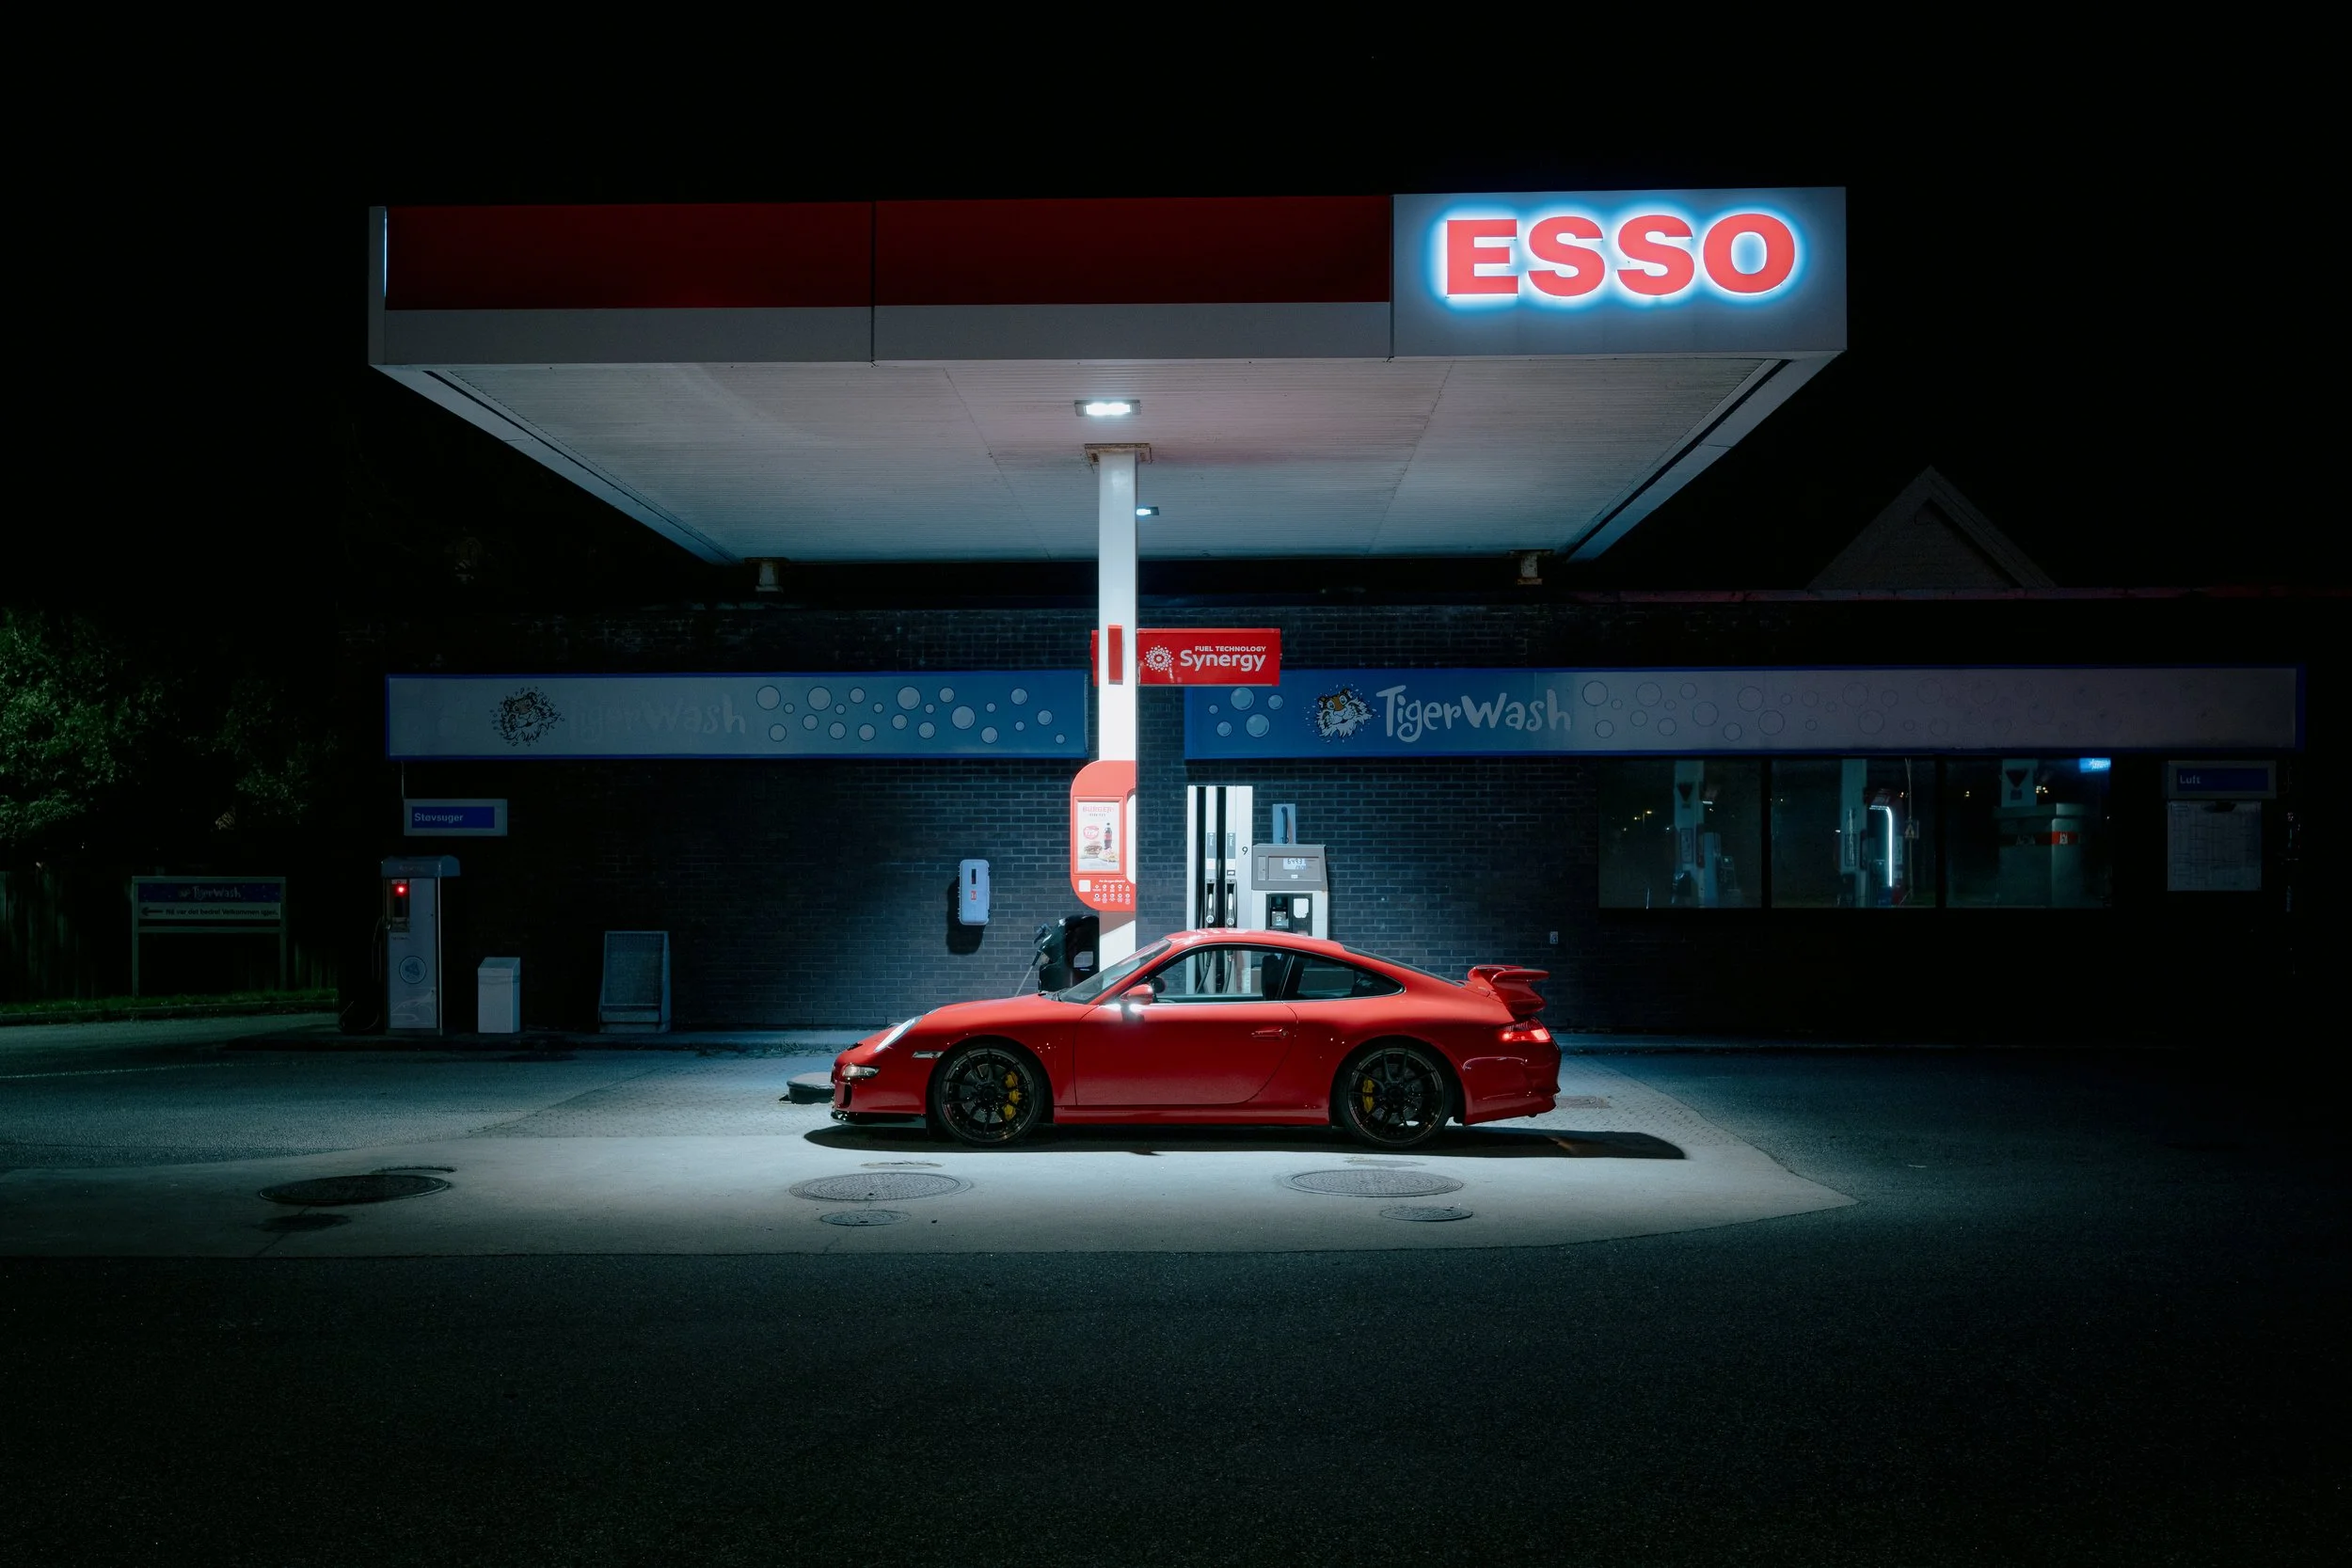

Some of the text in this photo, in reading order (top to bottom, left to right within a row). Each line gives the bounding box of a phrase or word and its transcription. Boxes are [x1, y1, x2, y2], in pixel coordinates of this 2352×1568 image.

[1447, 214, 1795, 296] ESSO
[1180, 650, 1266, 672] Synergy
[1376, 685, 1572, 742] TigerWash
[2179, 774, 2202, 784] Luft
[1242, 847, 1248, 855] 9
